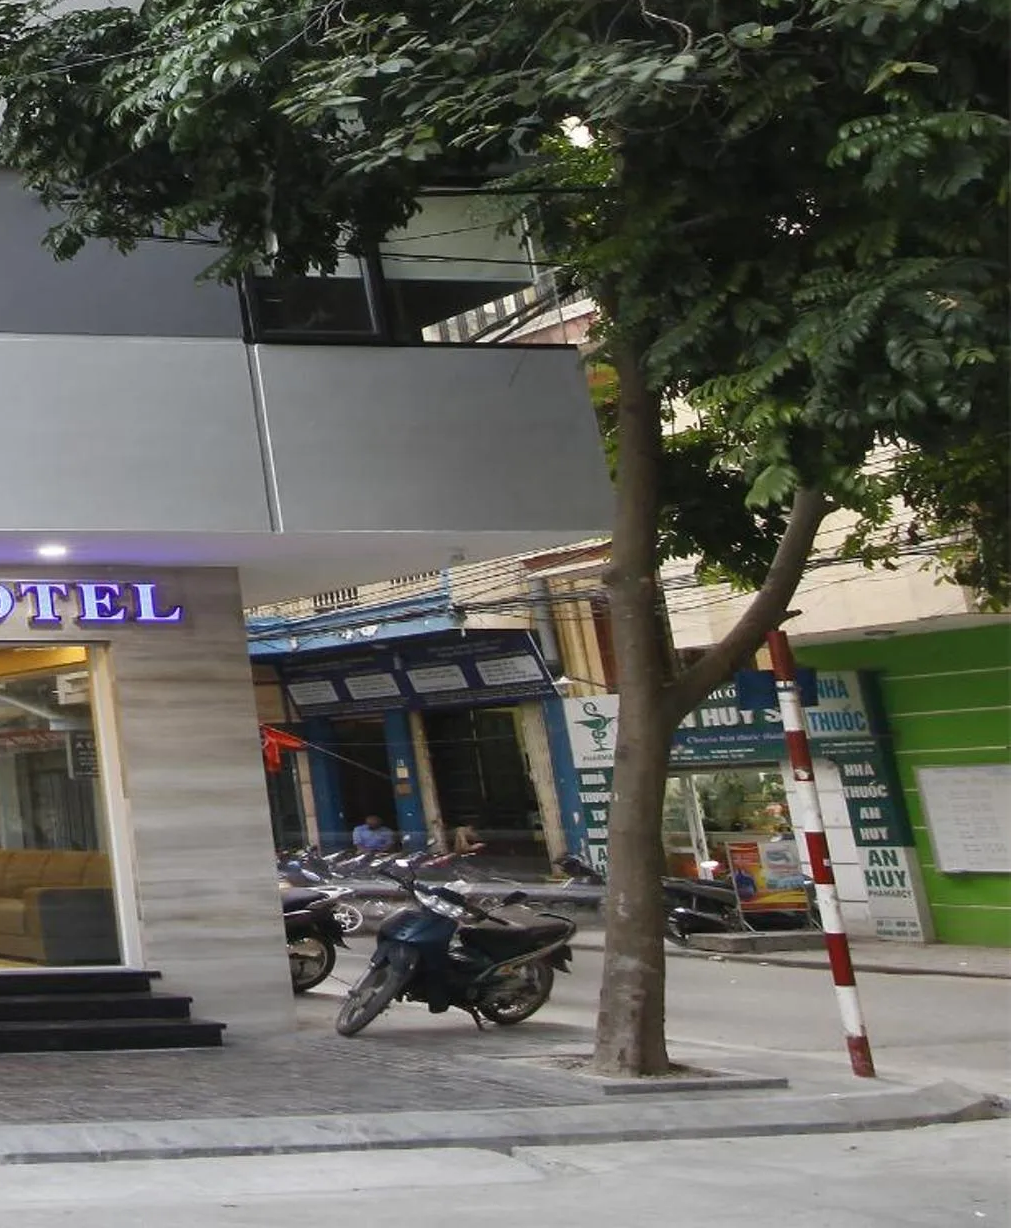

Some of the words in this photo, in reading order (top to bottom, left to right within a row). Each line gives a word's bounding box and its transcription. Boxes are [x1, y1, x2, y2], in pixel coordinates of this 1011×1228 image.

[808, 704, 866, 731] THUỐC
[843, 780, 888, 798] THUỐC
[860, 807, 882, 820] AN
[859, 827, 889, 840] HUY
[868, 849, 899, 866] AN
[863, 870, 906, 887] HUY
